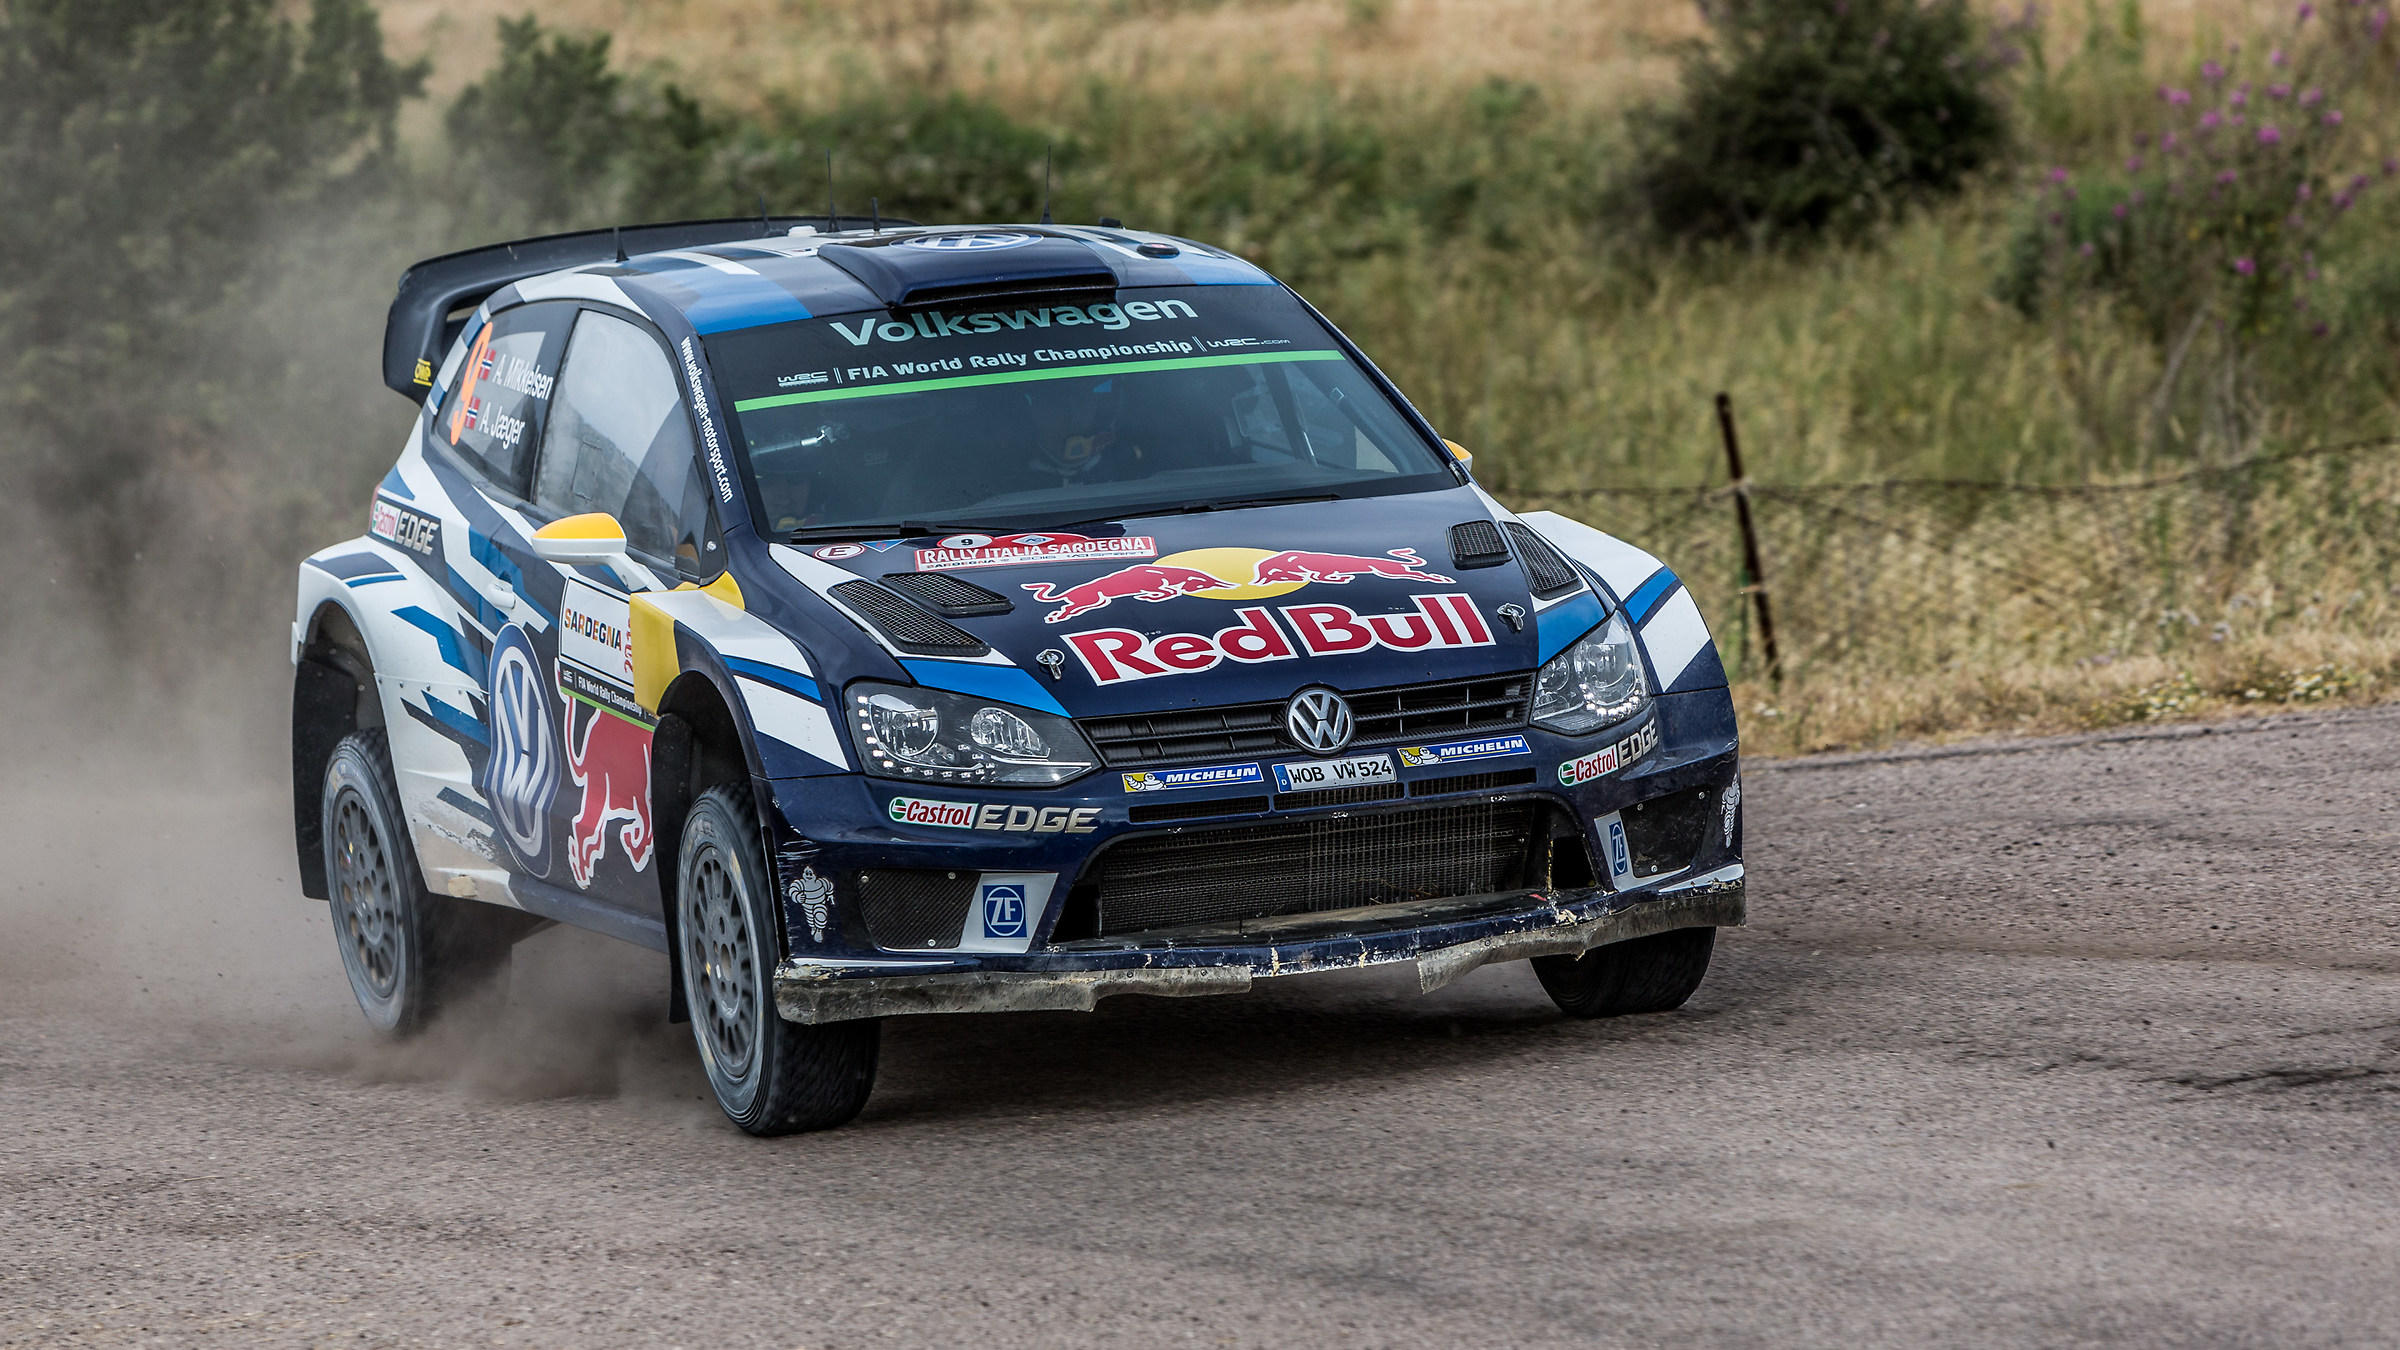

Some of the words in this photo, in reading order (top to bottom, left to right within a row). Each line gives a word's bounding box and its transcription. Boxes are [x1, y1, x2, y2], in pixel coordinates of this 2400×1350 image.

[829, 298, 1199, 347] Volkswagen
[491, 353, 506, 386] A.
[503, 356, 554, 400] Mikkelsen
[847, 367, 888, 381] FIA
[892, 357, 963, 375] World
[969, 352, 1027, 368] Rally
[1033, 340, 1193, 362] Championship
[451, 322, 493, 446] 9
[478, 402, 492, 434] A.
[489, 405, 526, 450] Jæger
[680, 336, 735, 504] www.volkswagen-motorsport.com
[395, 510, 440, 556] EDGE
[827, 546, 851, 557] E
[924, 548, 977, 563] RALLY
[984, 545, 1041, 557] ITALIA
[1047, 538, 1146, 554] SARDEGNA
[960, 538, 973, 546] 9
[564, 608, 622, 651] SARDEGNA
[1065, 606, 1296, 684] Red
[1280, 595, 1493, 657] Bull
[1440, 739, 1523, 757] MICHELIN
[1574, 746, 1617, 783] Castrol
[1617, 716, 1659, 769] EDGE
[1165, 766, 1257, 783] MICHELIN
[1289, 766, 1325, 783] WOB
[906, 800, 972, 826] Castrol
[974, 803, 1103, 834] EDGE
[987, 897, 1021, 926] ZF
